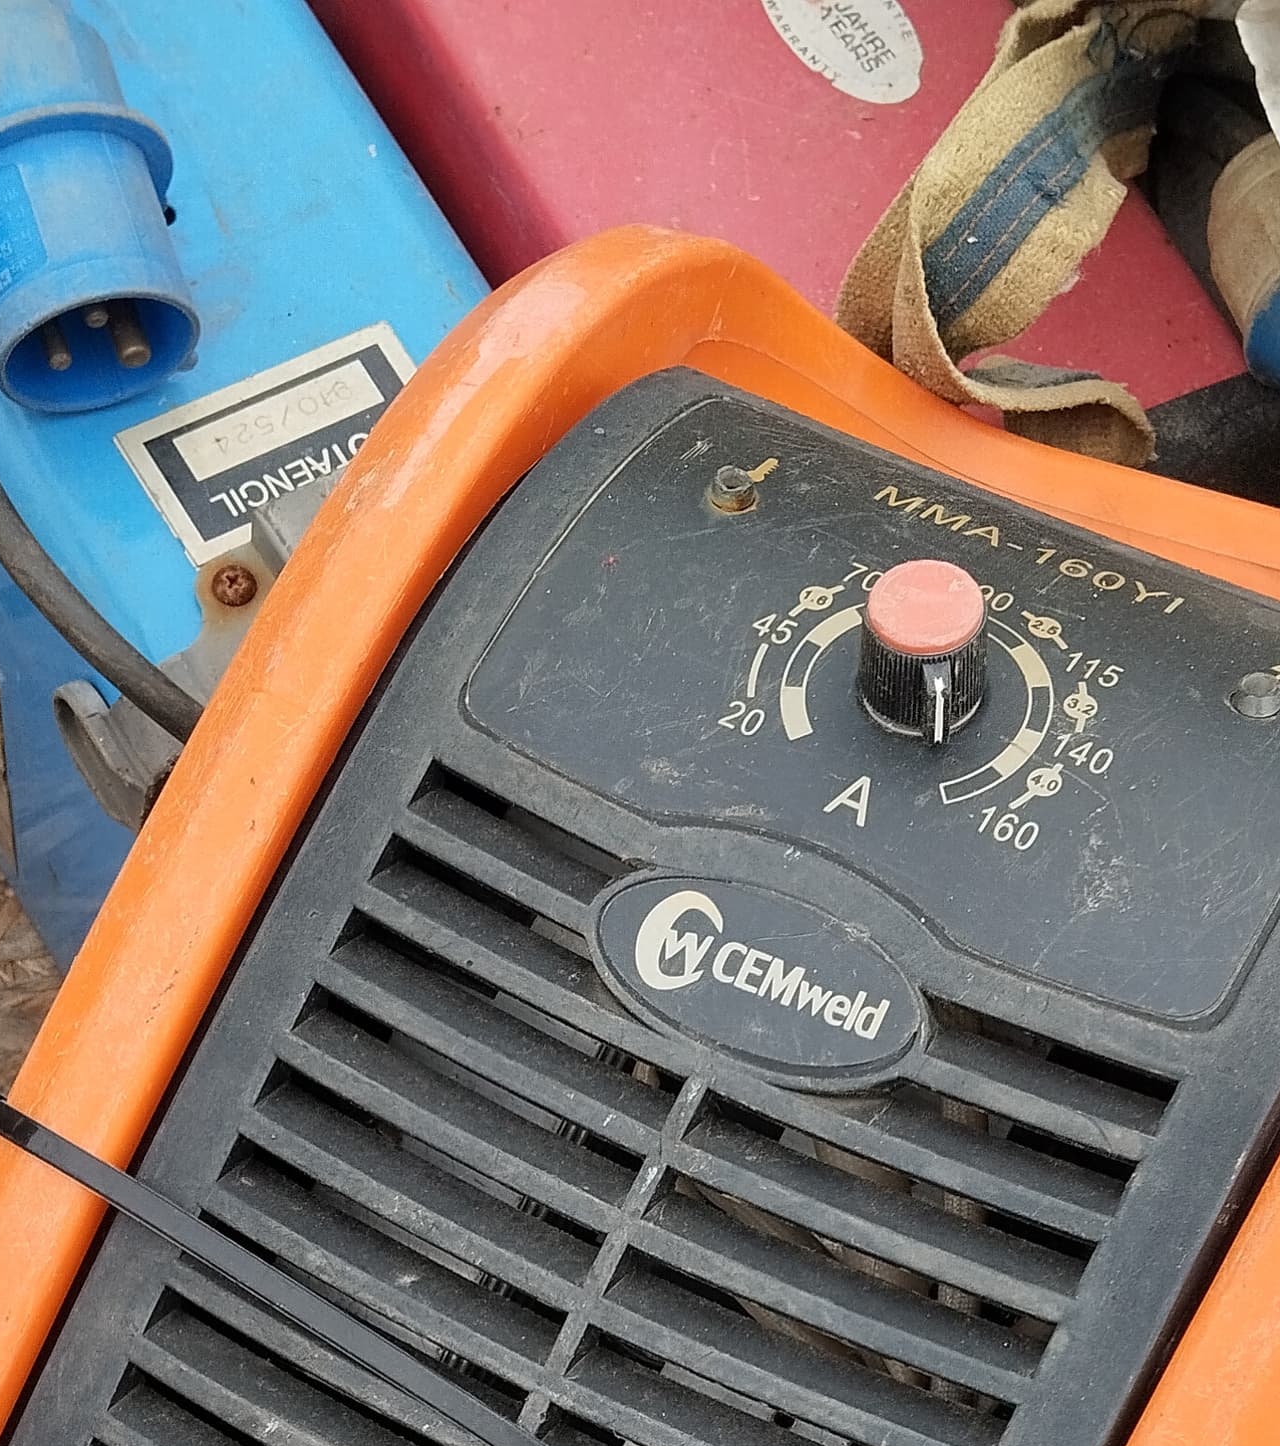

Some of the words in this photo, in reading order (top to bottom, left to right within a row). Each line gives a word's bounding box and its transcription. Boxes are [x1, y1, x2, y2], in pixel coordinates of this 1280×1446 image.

[752, 613, 798, 644] 45
[1066, 651, 1124, 687] 115
[718, 700, 765, 736] 20
[1067, 697, 1096, 716] 3.2
[1053, 733, 1114, 775] 140
[1030, 773, 1059, 792] 4.0
[823, 775, 871, 827] A
[978, 806, 1039, 850] 160
[712, 941, 890, 1040] CEMweld
